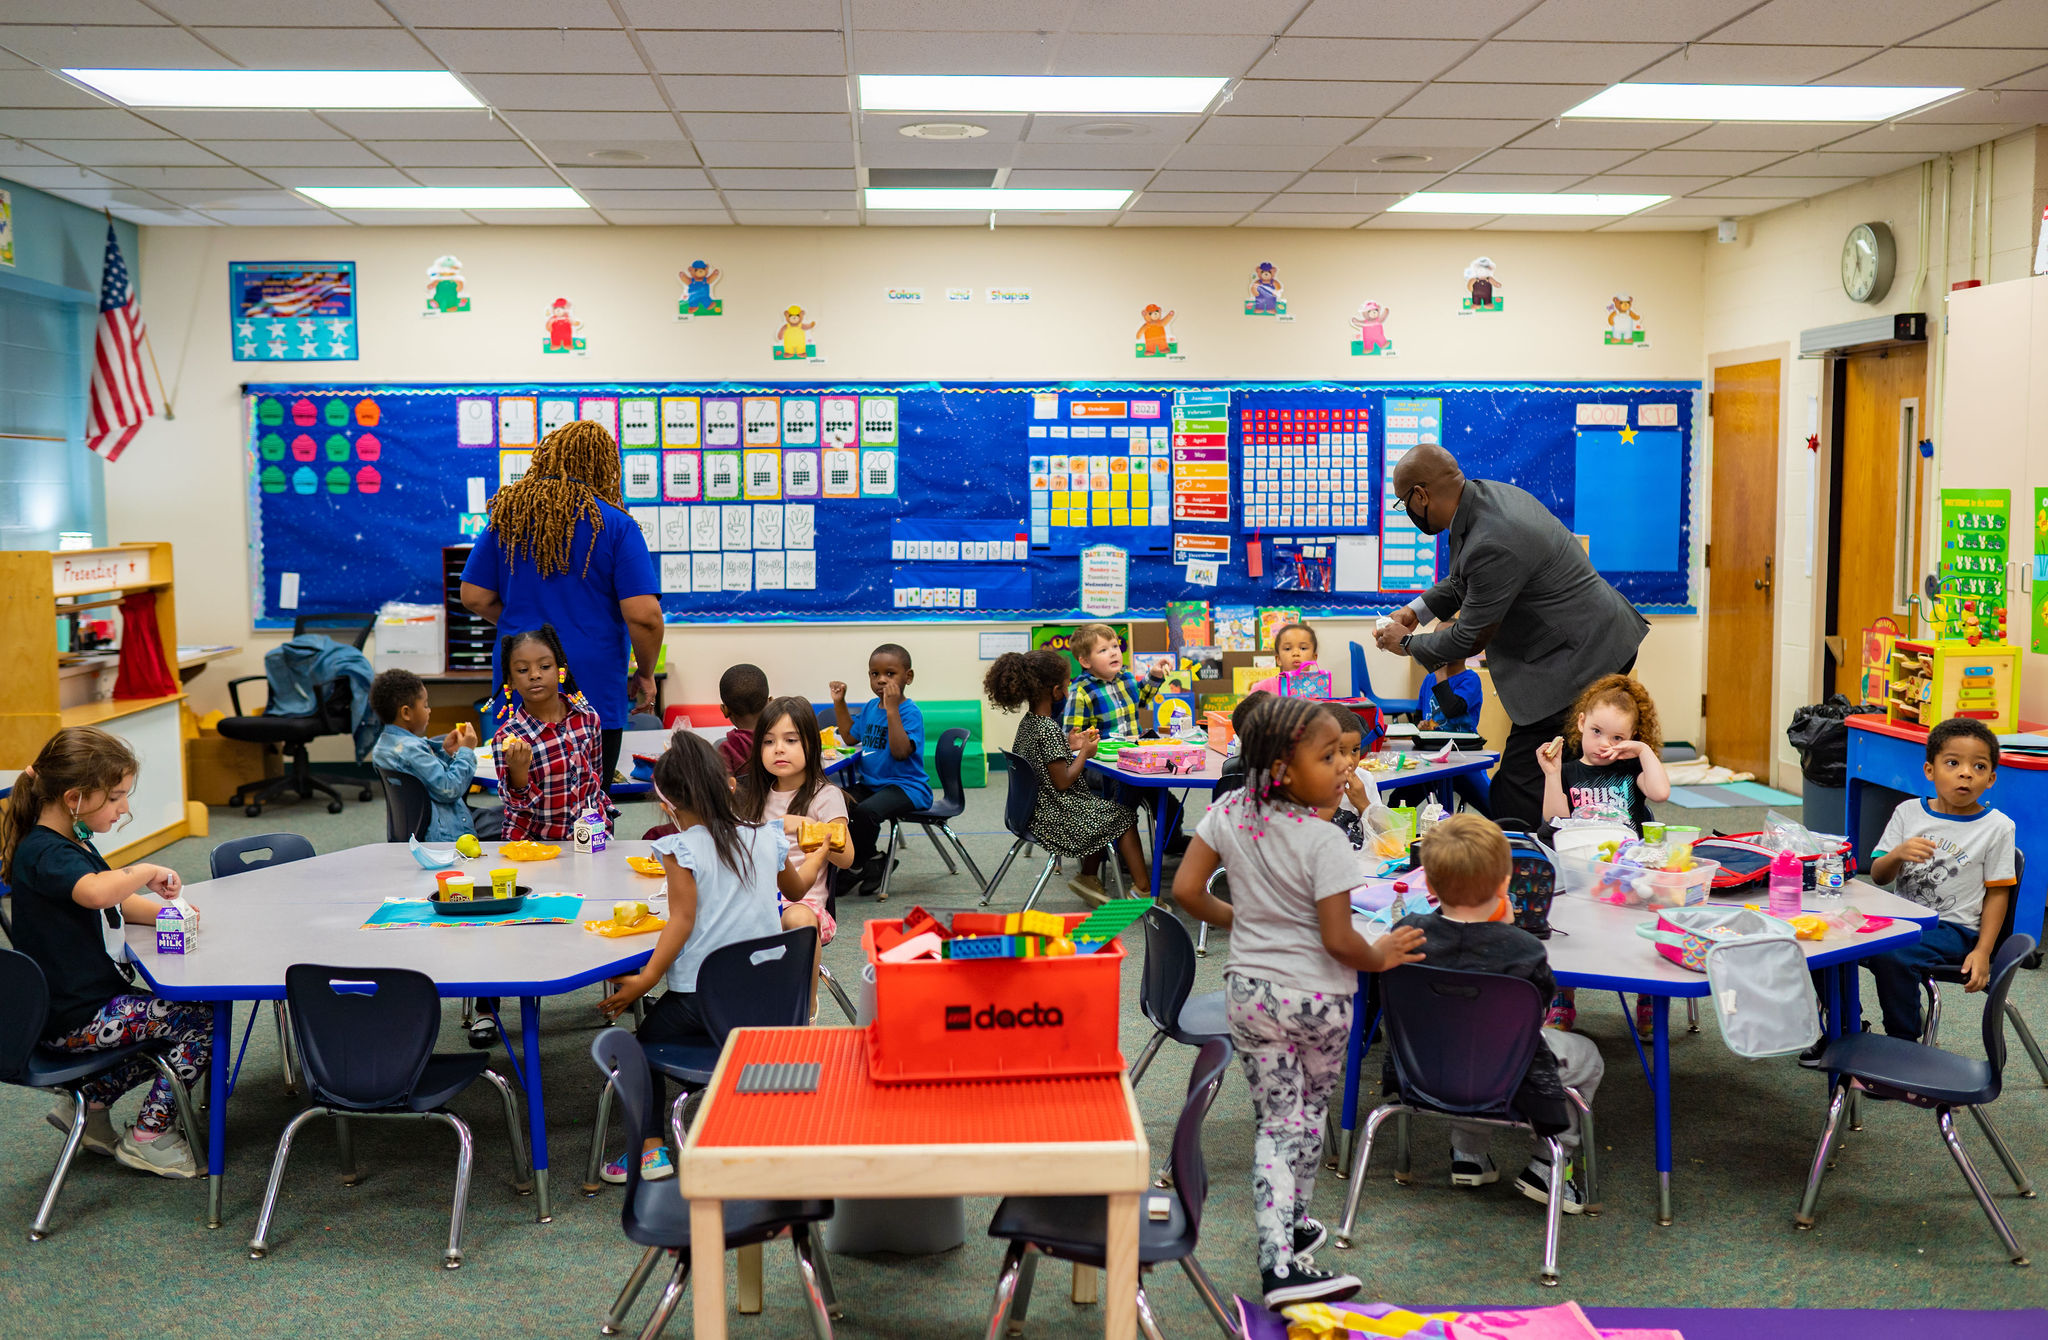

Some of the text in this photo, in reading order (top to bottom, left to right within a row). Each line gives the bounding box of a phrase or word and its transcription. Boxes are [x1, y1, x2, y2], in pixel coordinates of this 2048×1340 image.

[888, 289, 920, 300] Colors
[992, 290, 1030, 302] Shapes
[468, 402, 483, 420] 0
[553, 403, 564, 420] 2
[594, 403, 603, 420] 3
[632, 403, 643, 420] 4
[676, 402, 686, 420] 5
[717, 402, 727, 420] 6
[756, 402, 766, 419] 7
[795, 402, 805, 419] 8
[834, 402, 844, 418] 9
[870, 401, 888, 418] 10
[1134, 405, 1156, 414] 2021
[1578, 406, 1676, 424] COOL KID
[633, 456, 649, 473] 14
[674, 456, 690, 473] 15
[714, 456, 730, 472] 16
[755, 455, 768, 471] 17
[794, 454, 808, 470] 18
[833, 453, 847, 470] 19
[867, 453, 890, 470] 20
[992, 543, 997, 556] 8
[1004, 543, 1011, 557] 9
[1017, 543, 1025, 556] 10
[64, 559, 118, 588] Presenting
[1922, 681, 1931, 700] 6
[1937, 838, 1971, 867] BUDDIES
[975, 1002, 1063, 1029] dacta
